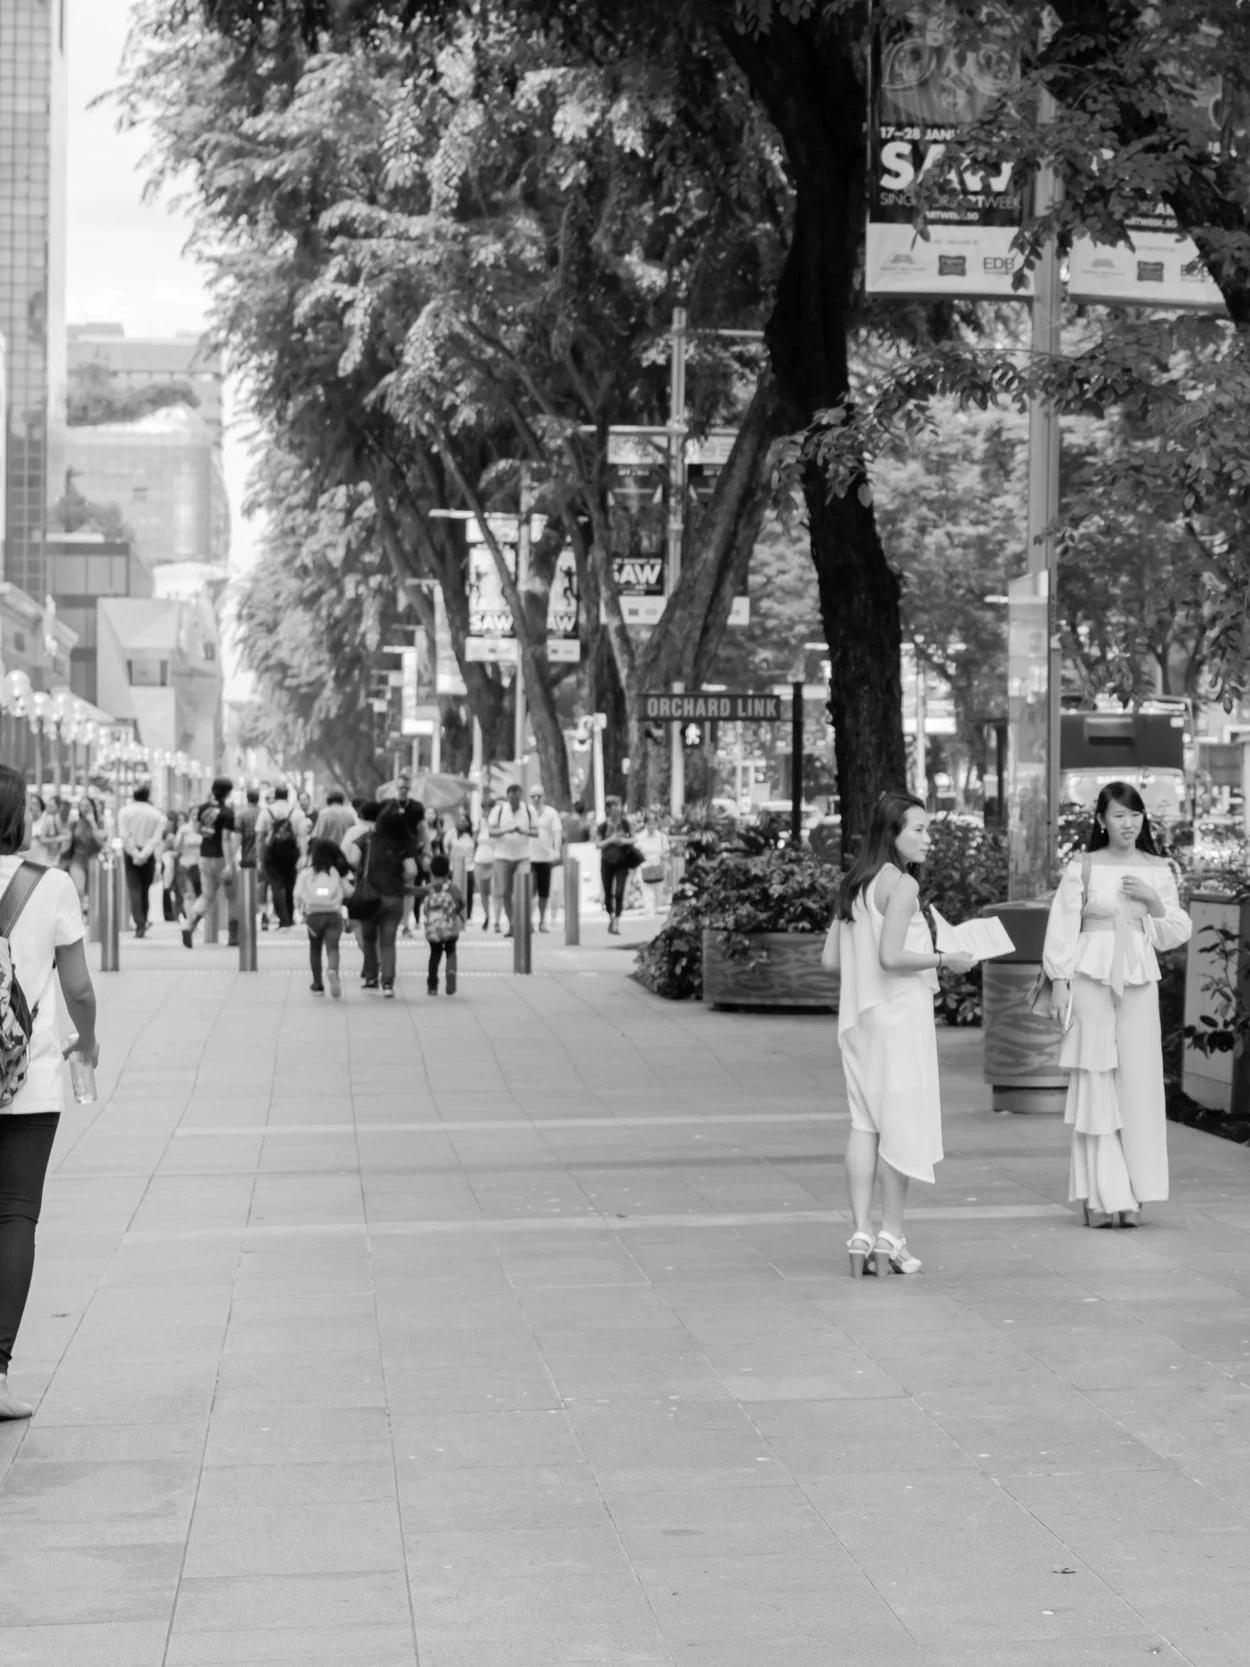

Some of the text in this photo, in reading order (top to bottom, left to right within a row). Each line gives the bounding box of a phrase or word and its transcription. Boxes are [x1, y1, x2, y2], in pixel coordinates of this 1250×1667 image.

[546, 616, 576, 632] AW
[647, 697, 777, 717] ORCHARD LINK
